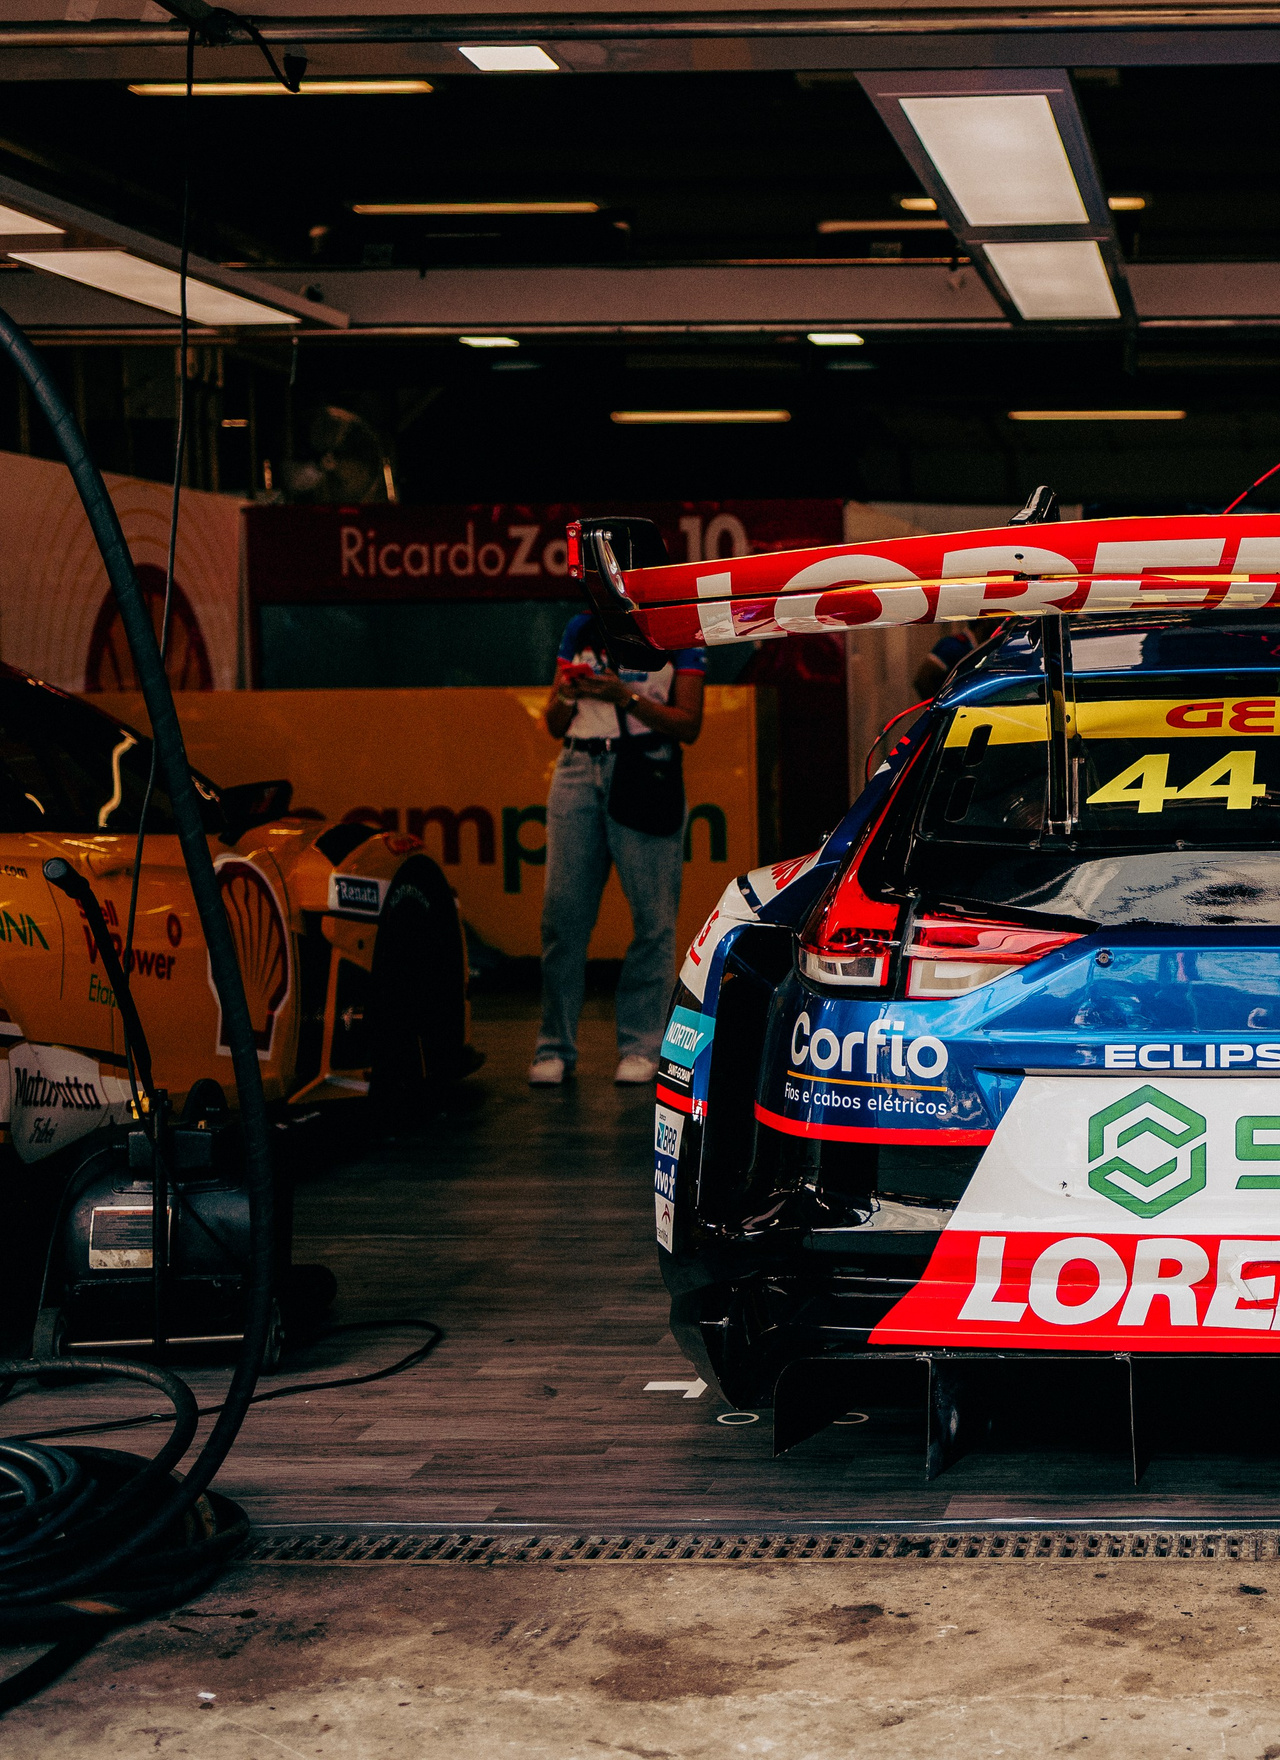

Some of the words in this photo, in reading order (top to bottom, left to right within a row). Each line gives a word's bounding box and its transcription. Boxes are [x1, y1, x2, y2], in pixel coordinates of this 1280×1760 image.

[340, 521, 568, 578] RicardoZo
[1086, 750, 1267, 813] 44
[340, 880, 378, 905] Renata
[665, 1021, 704, 1052] NORTON
[790, 1011, 949, 1079] Corfio
[15, 1067, 101, 1110] Maturatta
[785, 1081, 800, 1101] Fios
[802, 1090, 810, 1104] e
[814, 1089, 861, 1110] cabos
[867, 1092, 947, 1117] elétricos
[663, 1125, 678, 1156] BRB
